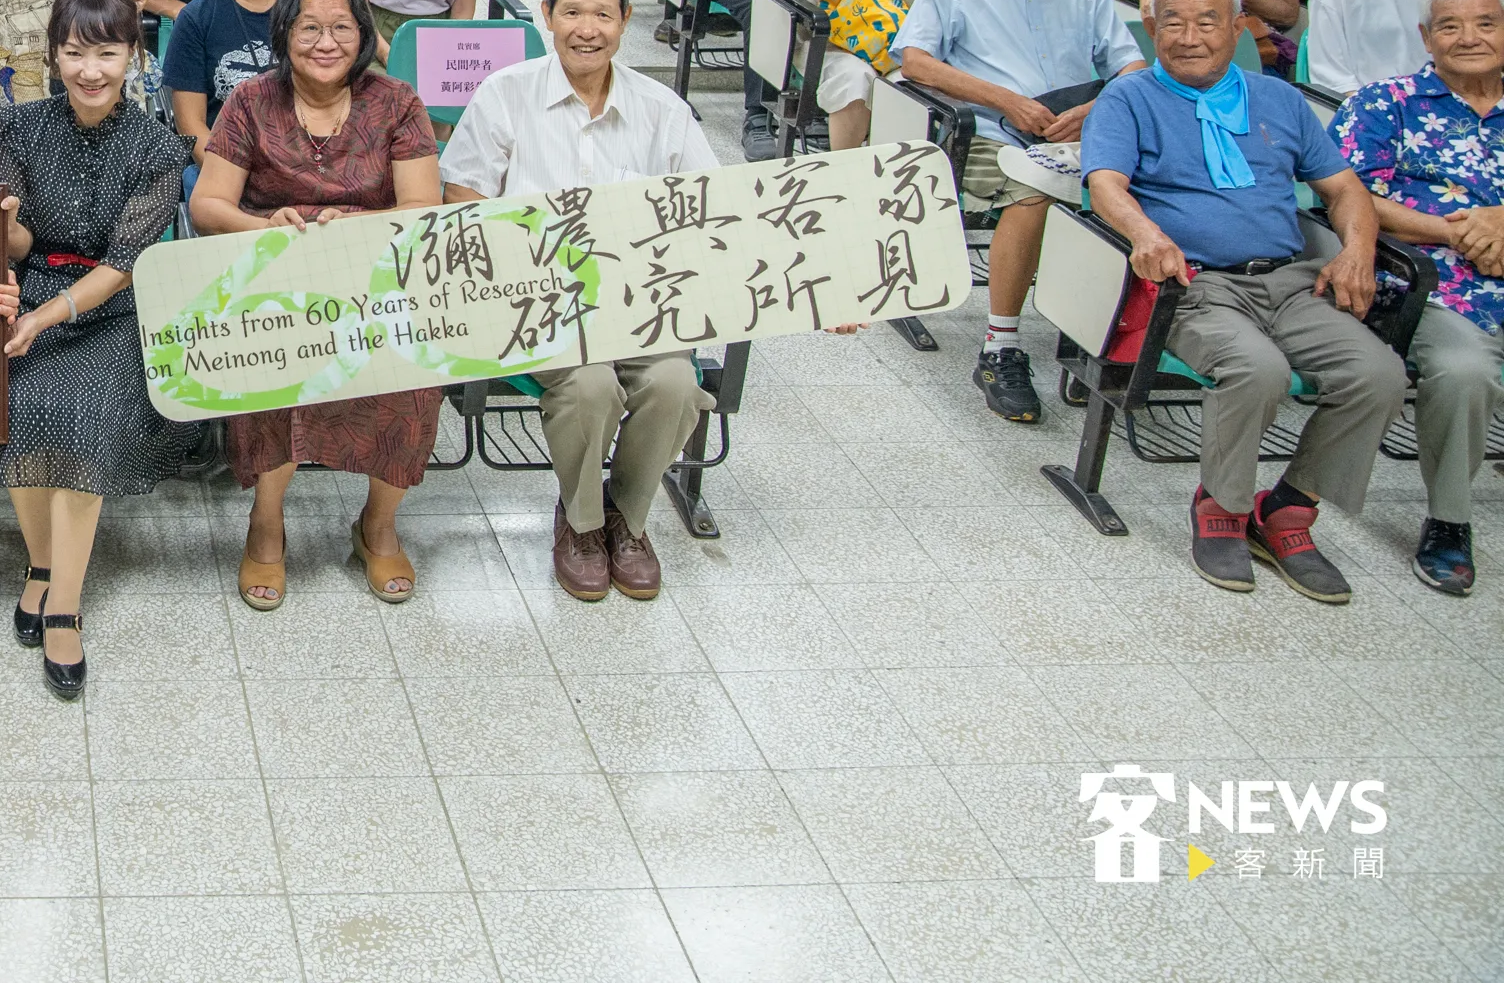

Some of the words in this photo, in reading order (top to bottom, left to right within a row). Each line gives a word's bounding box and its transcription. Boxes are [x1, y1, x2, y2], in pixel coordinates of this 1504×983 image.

[446, 59, 492, 71] 民間學者
[141, 315, 231, 351] Insights
[241, 309, 295, 339] from
[306, 299, 341, 326] 60
[350, 294, 420, 322] Years
[428, 283, 452, 310] of
[460, 268, 564, 303] Research
[146, 361, 173, 381] on
[183, 347, 286, 377] Meinong
[296, 332, 338, 359] and
[347, 324, 384, 353] the
[394, 315, 469, 346] Hakka
